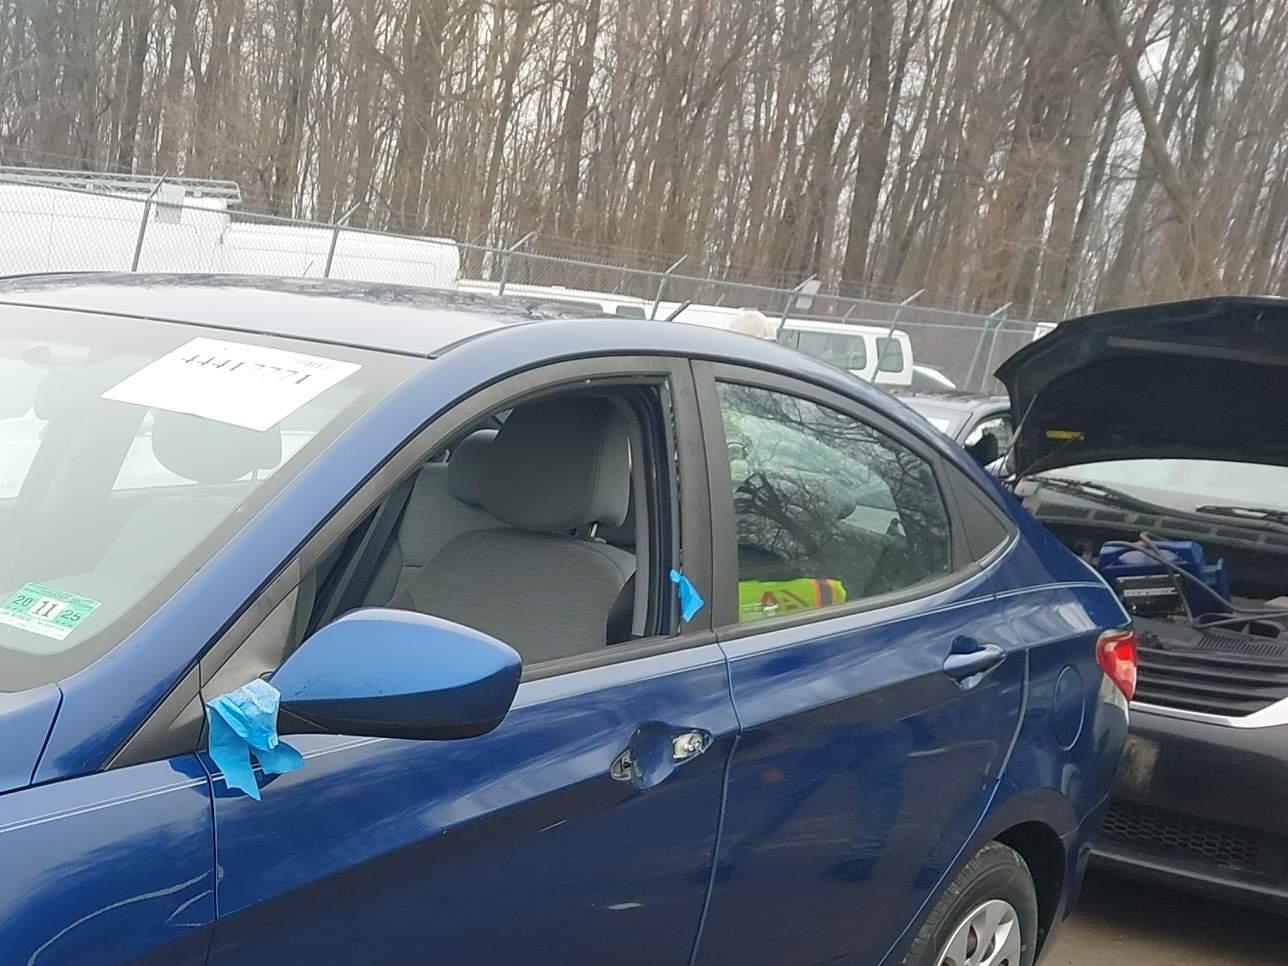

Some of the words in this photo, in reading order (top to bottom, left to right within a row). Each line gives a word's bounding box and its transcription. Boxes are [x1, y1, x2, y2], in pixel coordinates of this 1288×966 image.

[182, 354, 312, 385] 44417771
[12, 594, 34, 607] 20
[32, 600, 58, 618] 11
[61, 609, 82, 622] 25
